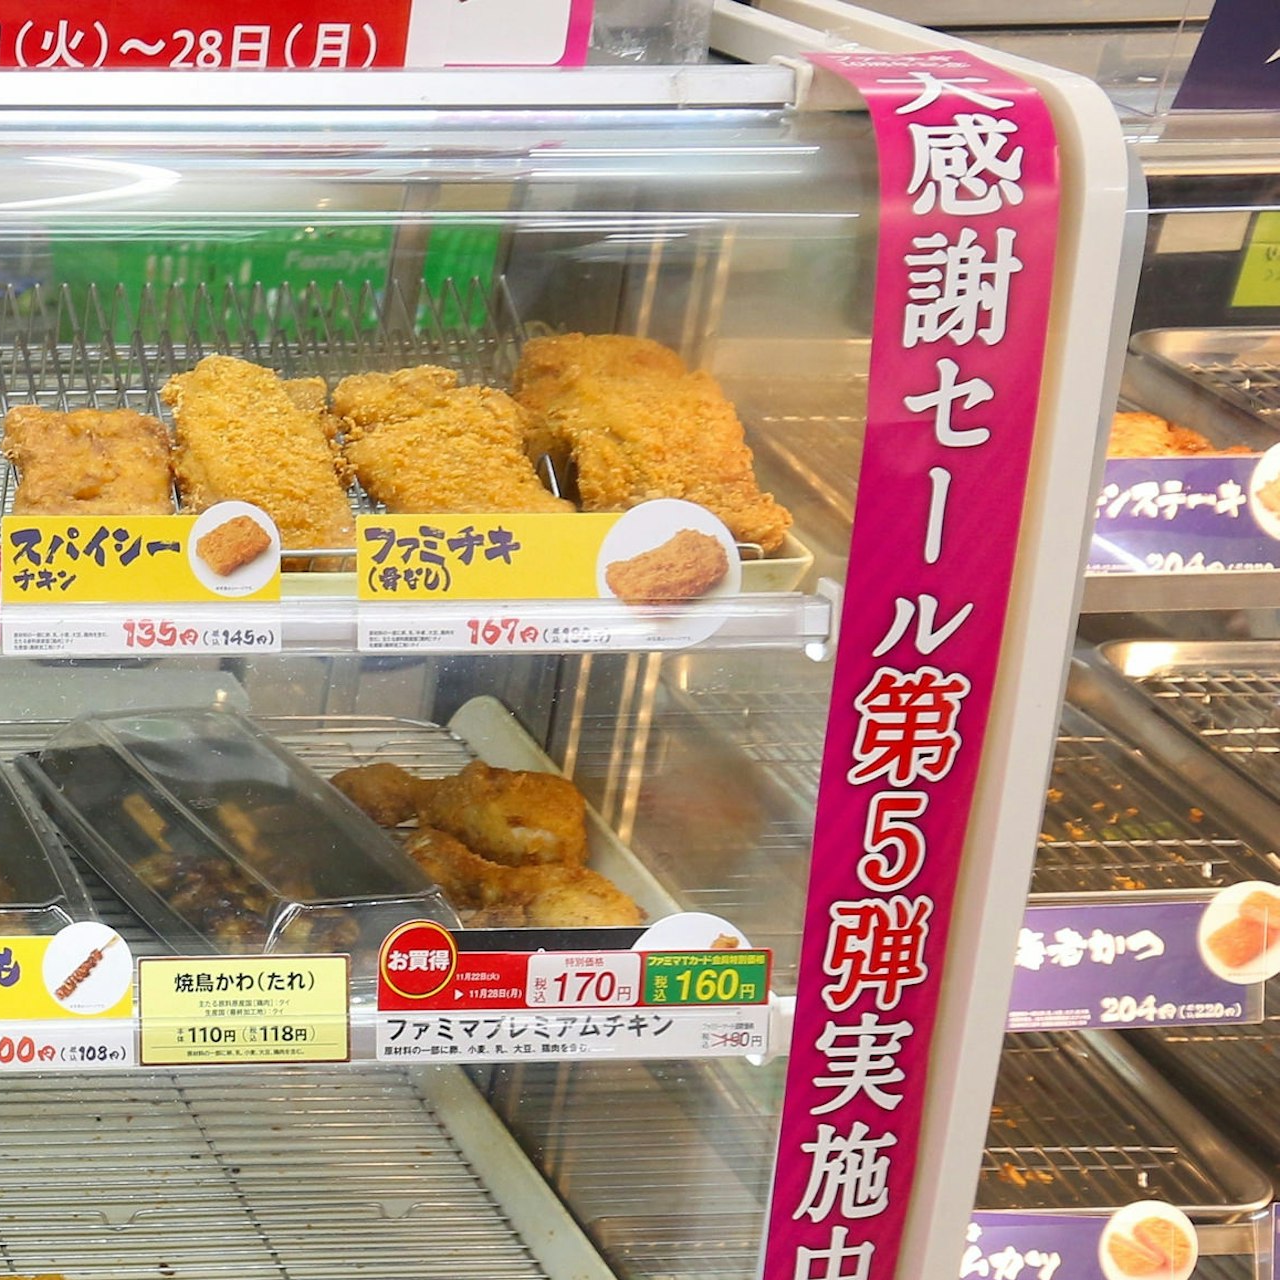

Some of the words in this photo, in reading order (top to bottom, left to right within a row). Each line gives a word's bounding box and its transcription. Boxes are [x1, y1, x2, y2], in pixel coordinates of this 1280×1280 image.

[10, 524, 182, 567] スパイシー
[364, 524, 521, 566] ファミチキ
[14, 568, 78, 595] チキン
[122, 617, 198, 648] 135円
[467, 616, 539, 647] 167円
[386, 949, 451, 972] お買得
[565, 956, 604, 967] 特別価格
[174, 972, 316, 994] 焼鳥かわ(たれ)
[386, 1015, 674, 1041] ファミマプレミアムチキン
